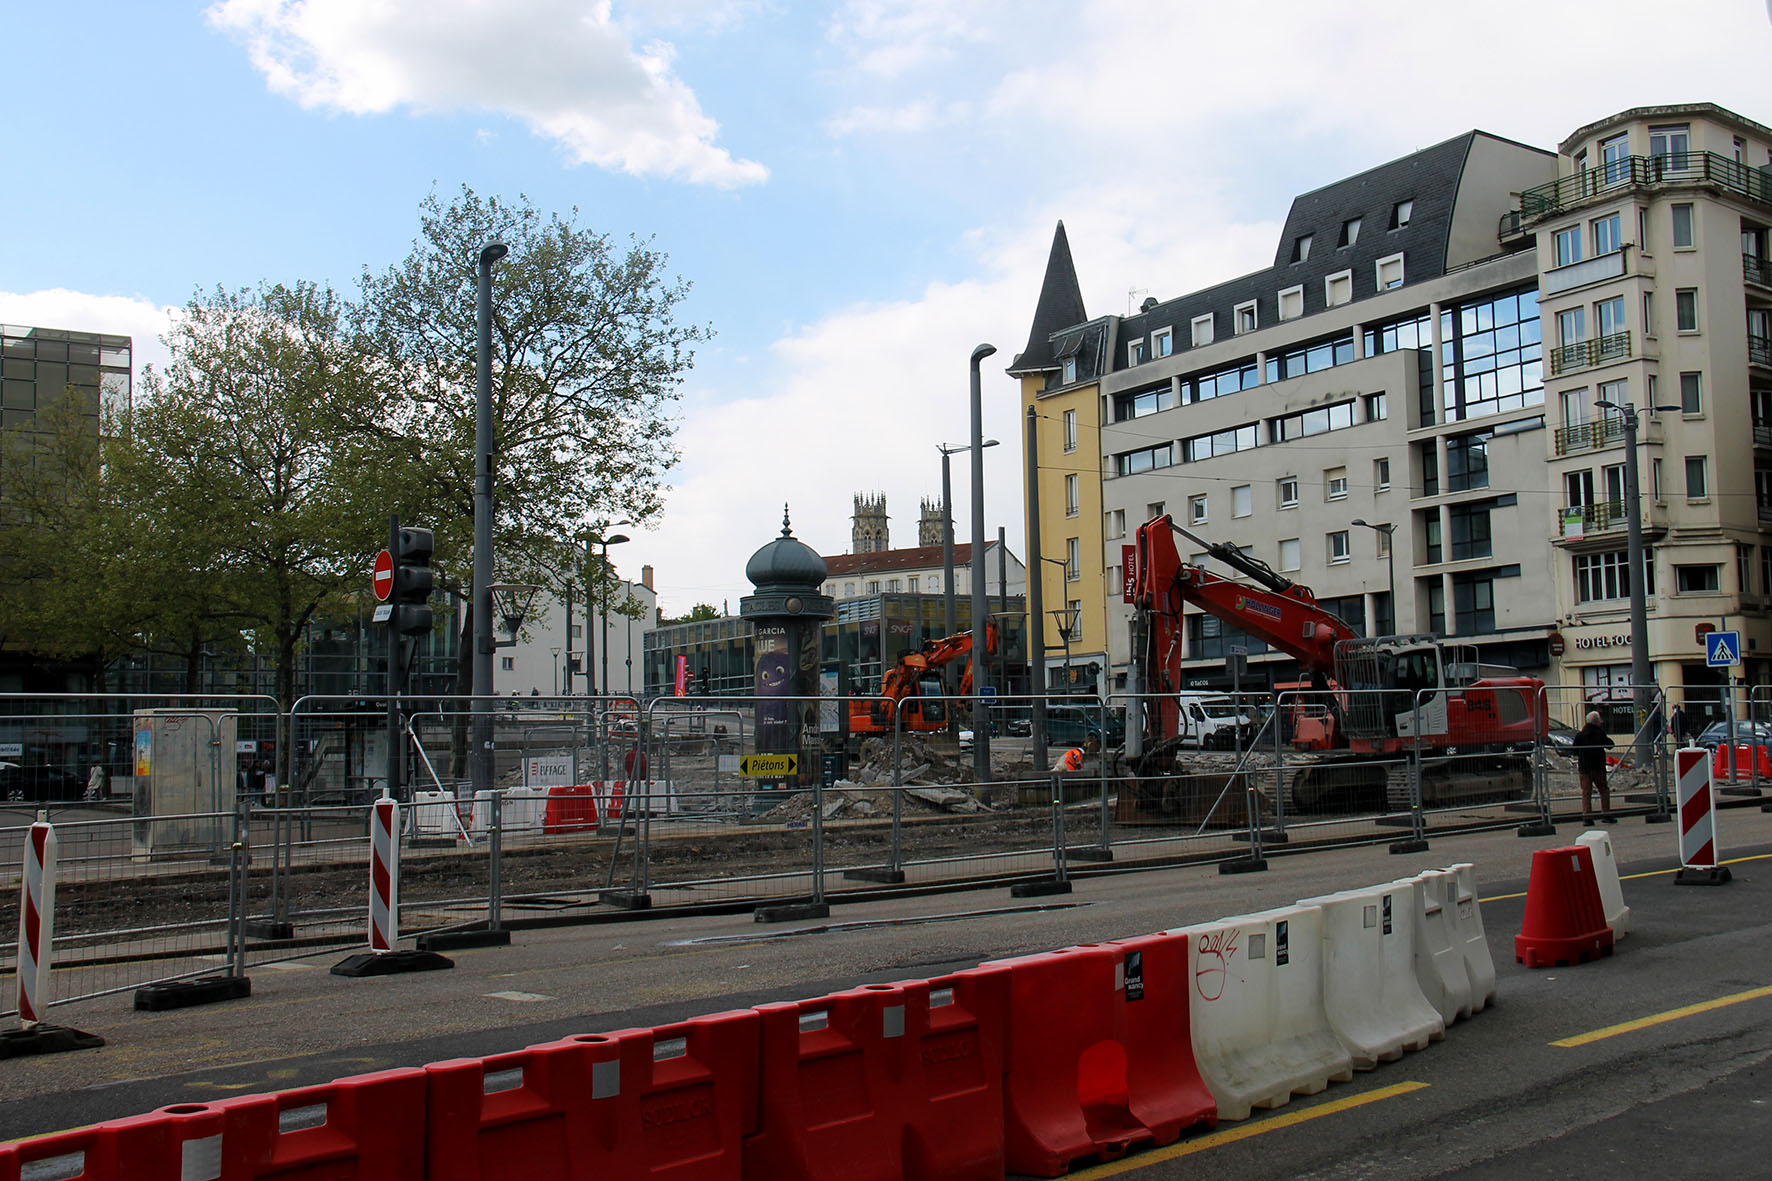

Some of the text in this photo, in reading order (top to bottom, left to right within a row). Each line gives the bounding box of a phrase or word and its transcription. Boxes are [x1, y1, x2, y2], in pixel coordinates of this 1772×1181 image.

[759, 627, 786, 635] GARCIA
[1575, 636, 1609, 649] HOTEL
[752, 760, 785, 771] Piétons
